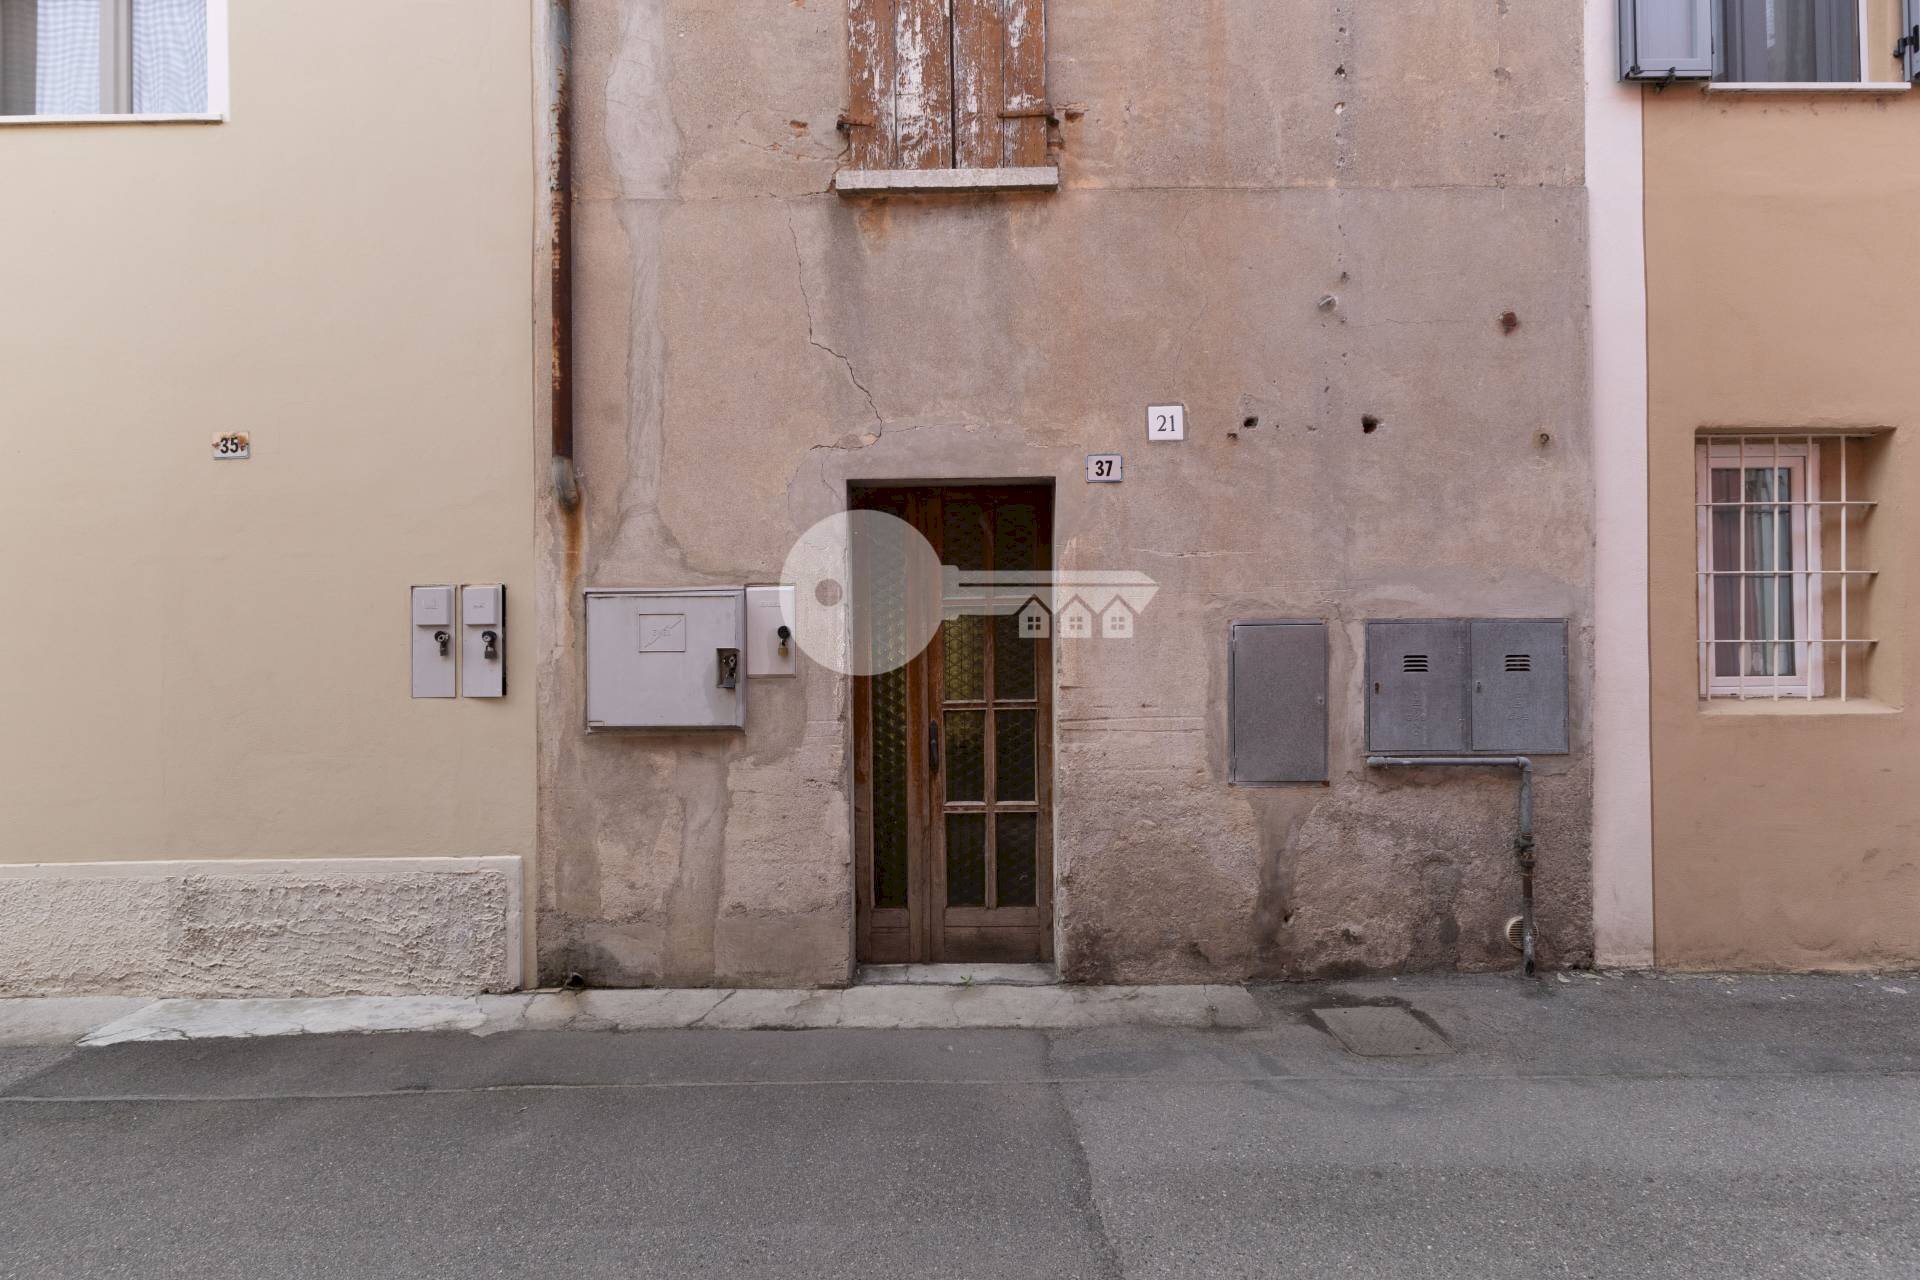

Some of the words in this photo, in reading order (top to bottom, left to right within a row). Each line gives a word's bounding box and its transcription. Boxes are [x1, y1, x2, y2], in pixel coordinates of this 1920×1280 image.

[1156, 414, 1176, 432] 21
[220, 437, 239, 454] 35
[1095, 460, 1113, 477] 37
